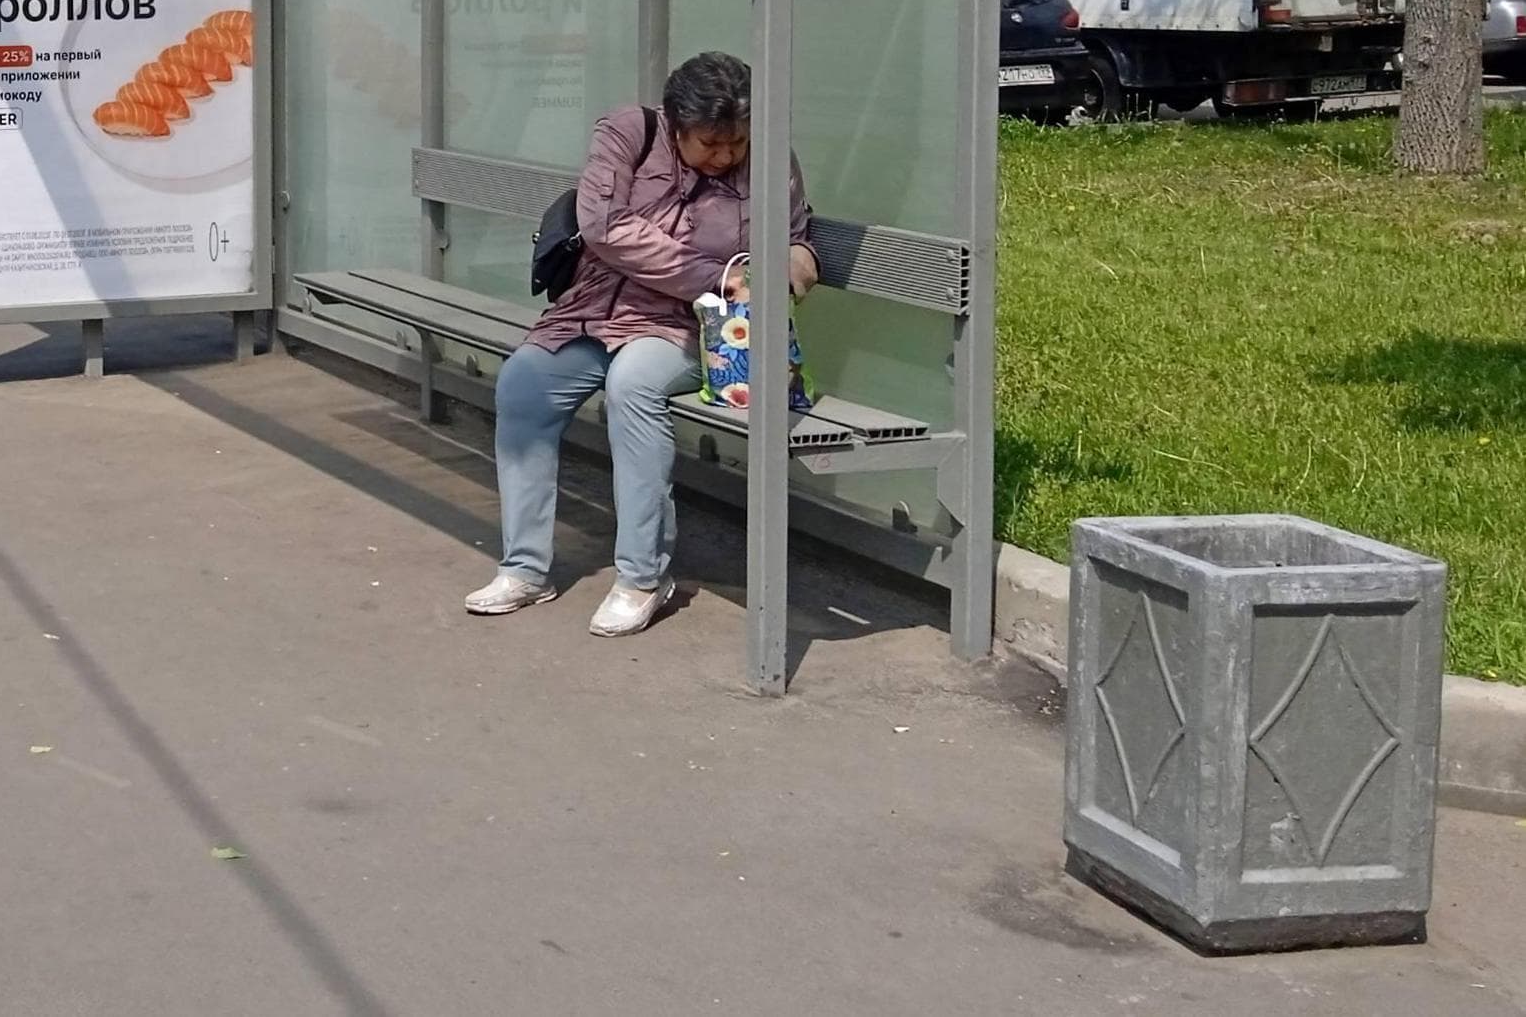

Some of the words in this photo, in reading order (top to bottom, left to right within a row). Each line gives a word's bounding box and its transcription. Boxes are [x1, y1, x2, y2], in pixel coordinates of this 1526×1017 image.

[2, 50, 30, 63] 25%
[36, 50, 51, 62] на
[53, 48, 102, 63] первый
[1, 70, 80, 83] приложении
[209, 221, 230, 262] 0+
